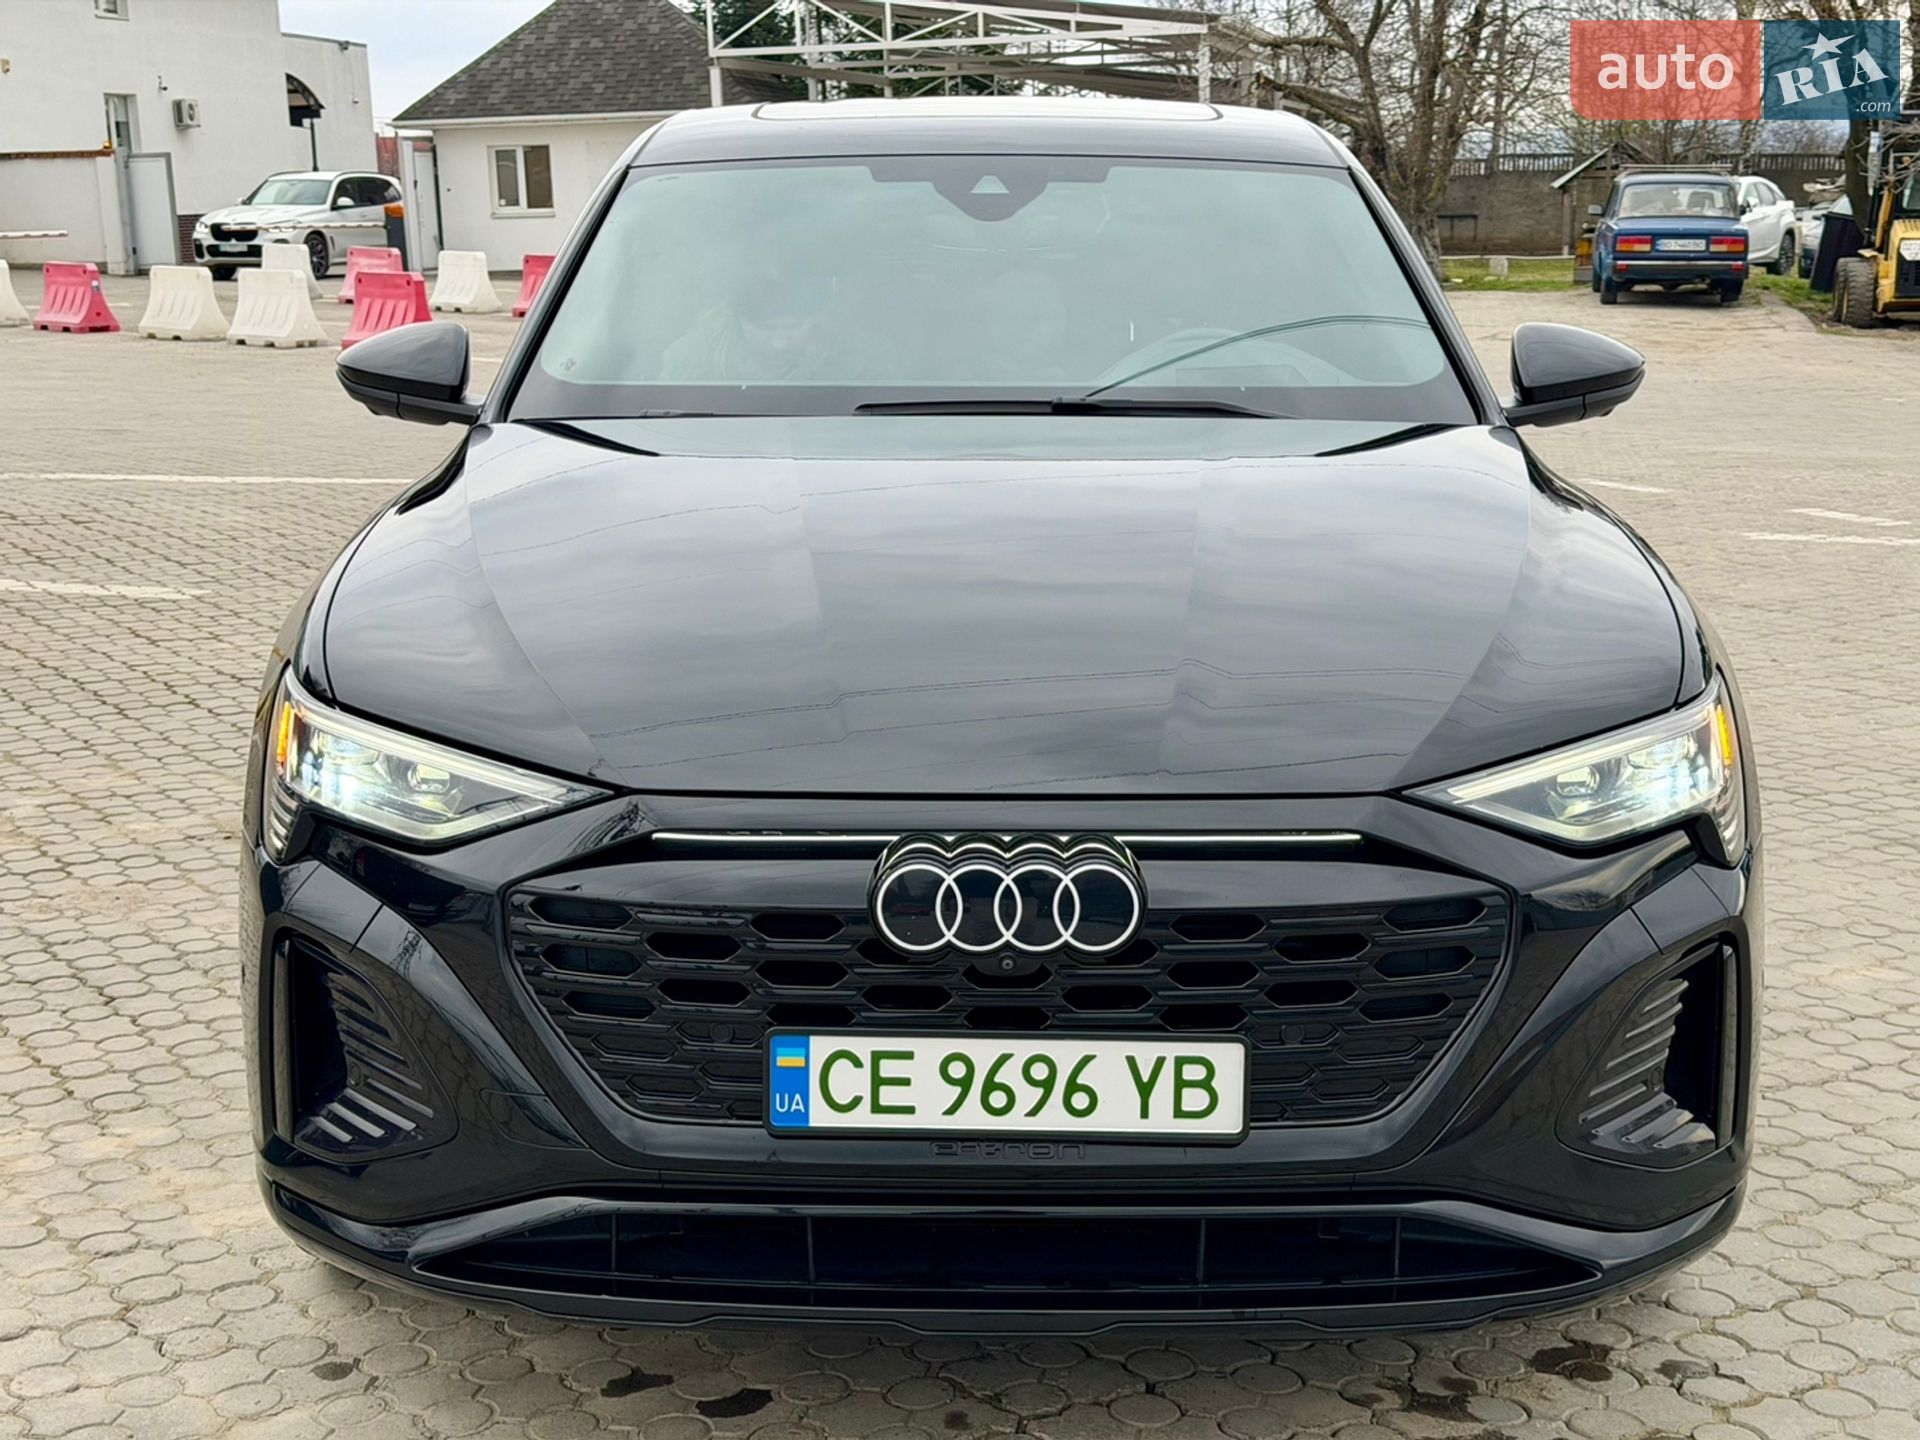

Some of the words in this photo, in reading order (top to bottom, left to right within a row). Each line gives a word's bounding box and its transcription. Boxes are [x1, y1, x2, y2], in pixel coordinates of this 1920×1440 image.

[819, 1049, 916, 1115] CE
[938, 1051, 1099, 1118] 9696
[1125, 1054, 1219, 1120] YB
[775, 1093, 806, 1113] UA
[929, 1140, 1085, 1160] e-tron
